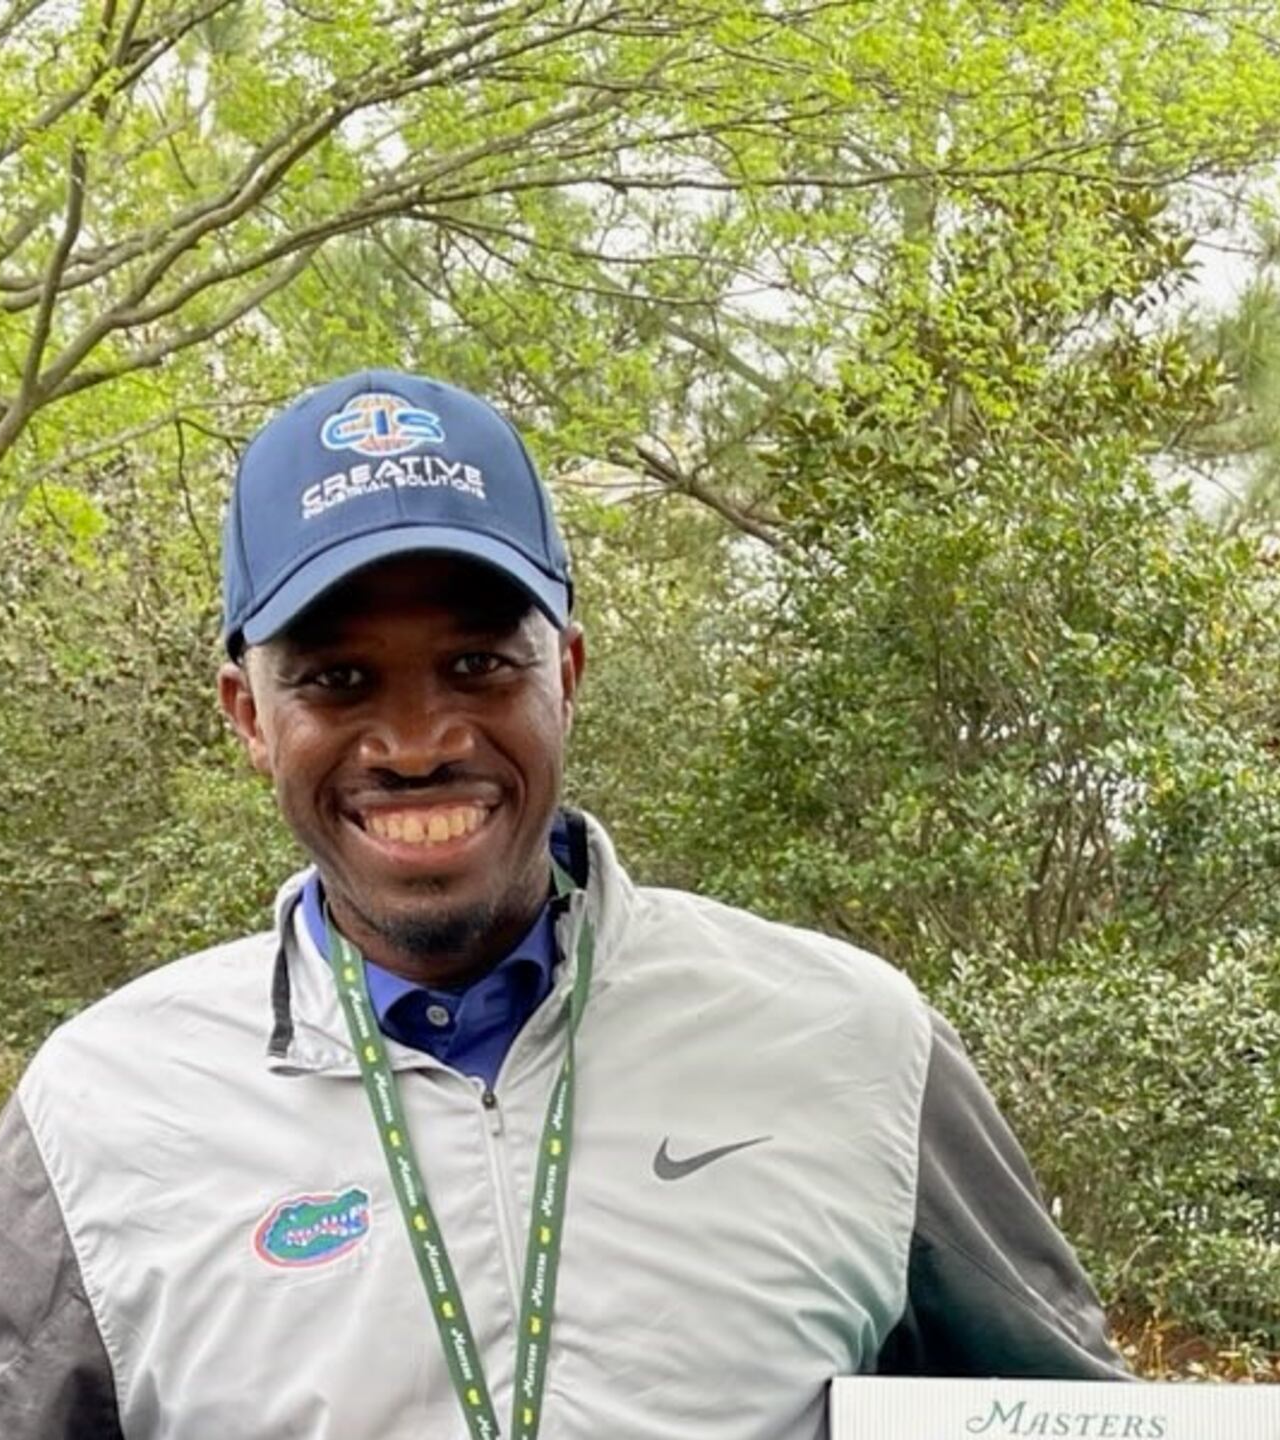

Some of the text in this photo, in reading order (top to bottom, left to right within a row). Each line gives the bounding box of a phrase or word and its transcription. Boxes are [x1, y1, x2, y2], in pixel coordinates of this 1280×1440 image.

[321, 408, 445, 450] CIS
[301, 455, 485, 507] CREATIVE
[965, 1399, 1168, 1440] MASTERS
